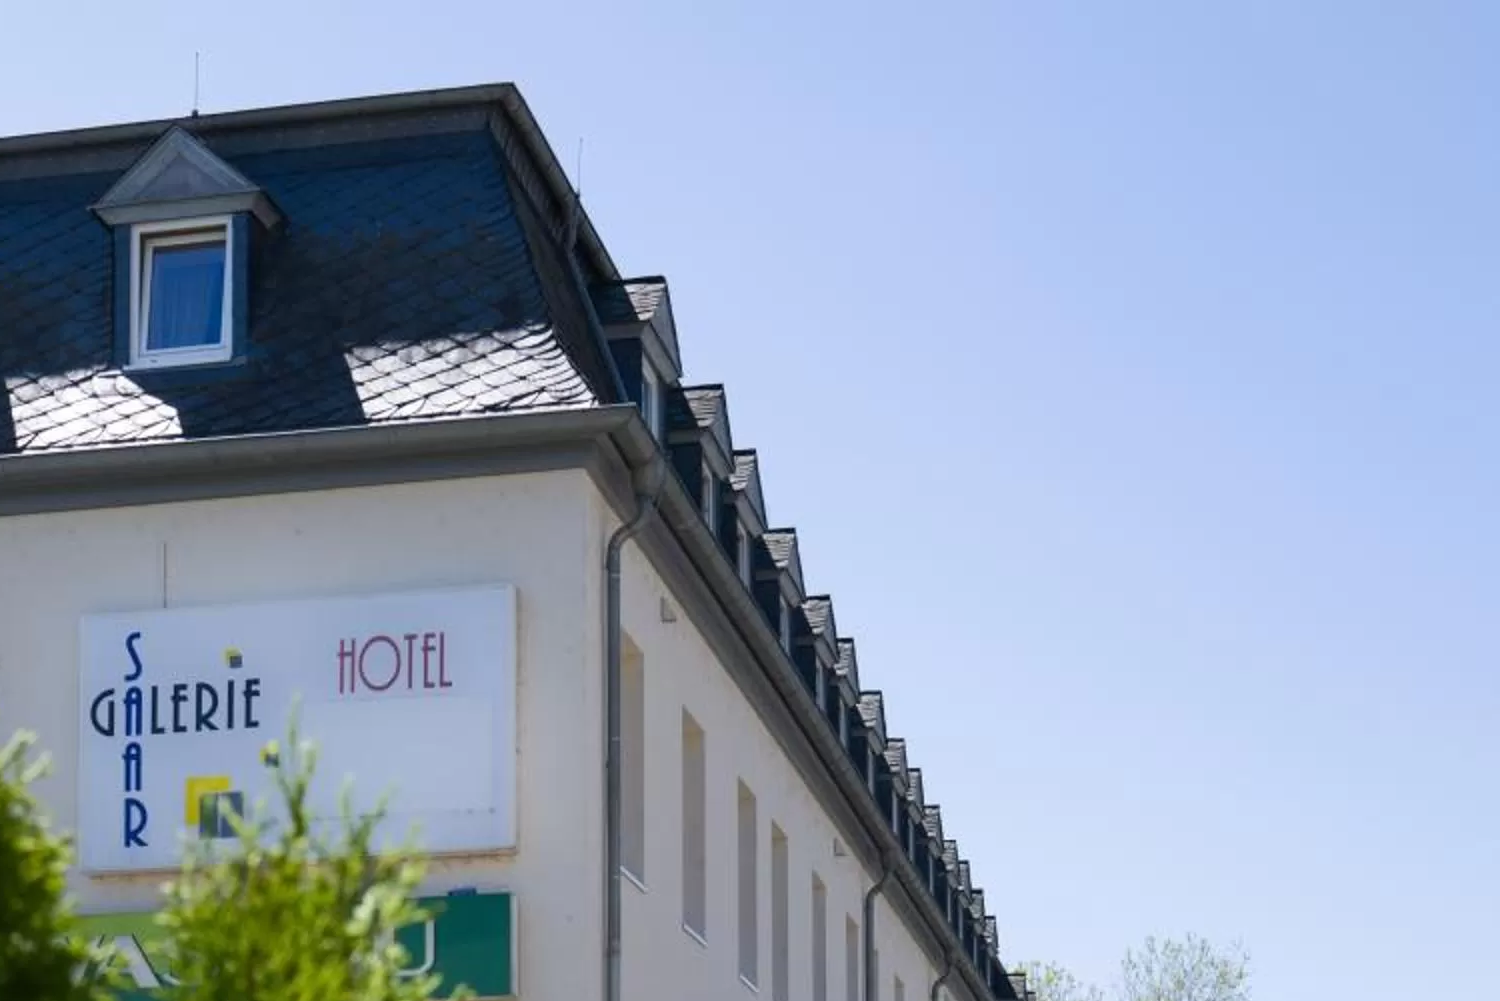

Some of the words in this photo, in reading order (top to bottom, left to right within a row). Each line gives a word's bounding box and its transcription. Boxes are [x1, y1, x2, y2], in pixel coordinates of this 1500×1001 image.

[337, 631, 453, 694] HOTEL
[90, 678, 261, 737] GALERIE
[122, 631, 149, 848] SAAR
